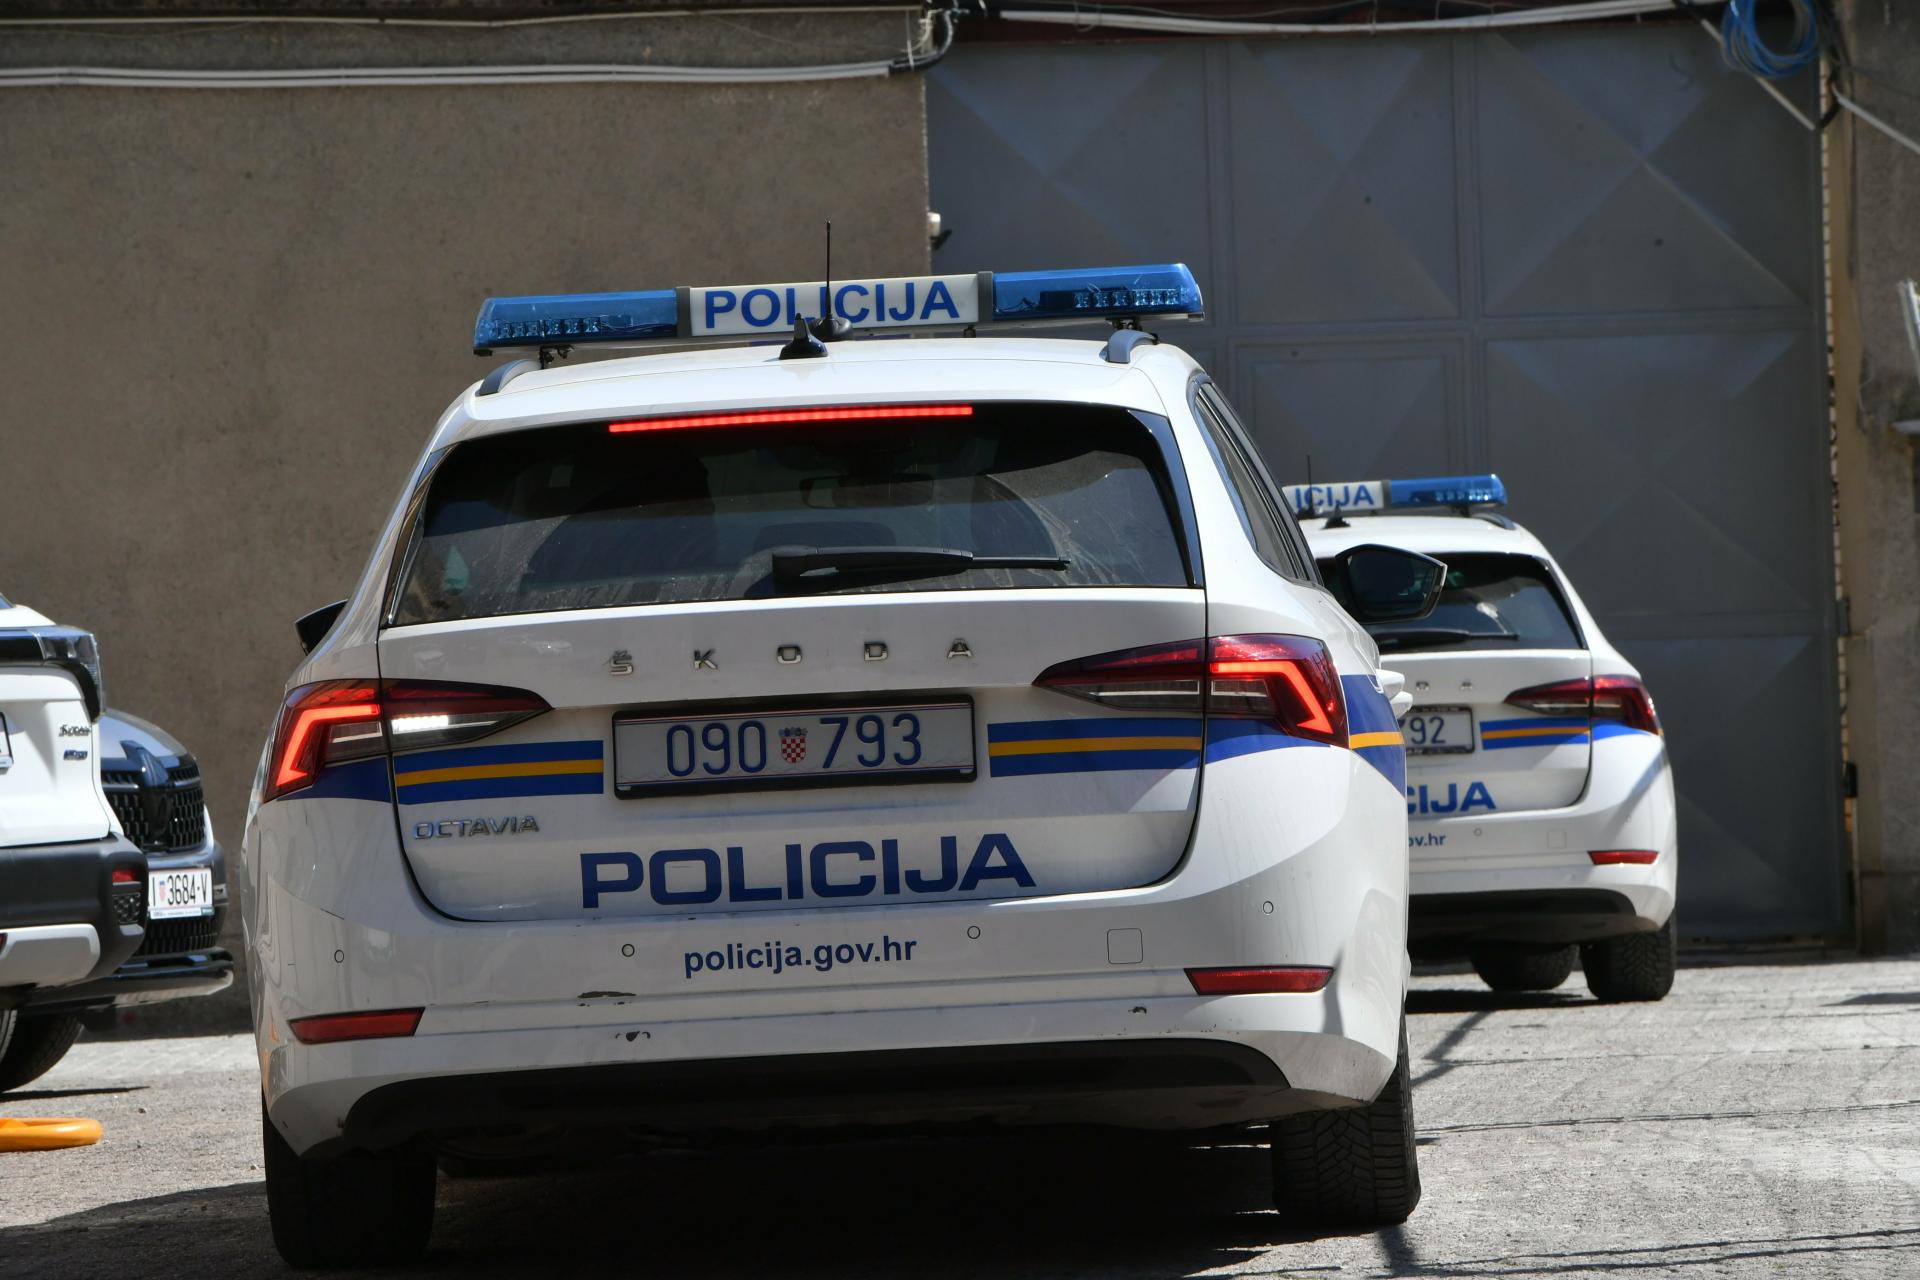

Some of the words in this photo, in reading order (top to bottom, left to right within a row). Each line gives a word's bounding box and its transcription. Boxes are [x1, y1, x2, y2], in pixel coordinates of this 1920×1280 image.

[704, 280, 960, 329] POLICIJA
[1294, 484, 1375, 513] ICIJA
[666, 719, 767, 777] 090
[819, 712, 922, 769] 793
[412, 815, 540, 840] OCTAVIA
[579, 833, 1036, 909] POLICIJA
[683, 935, 917, 978] policija.gov.hr
